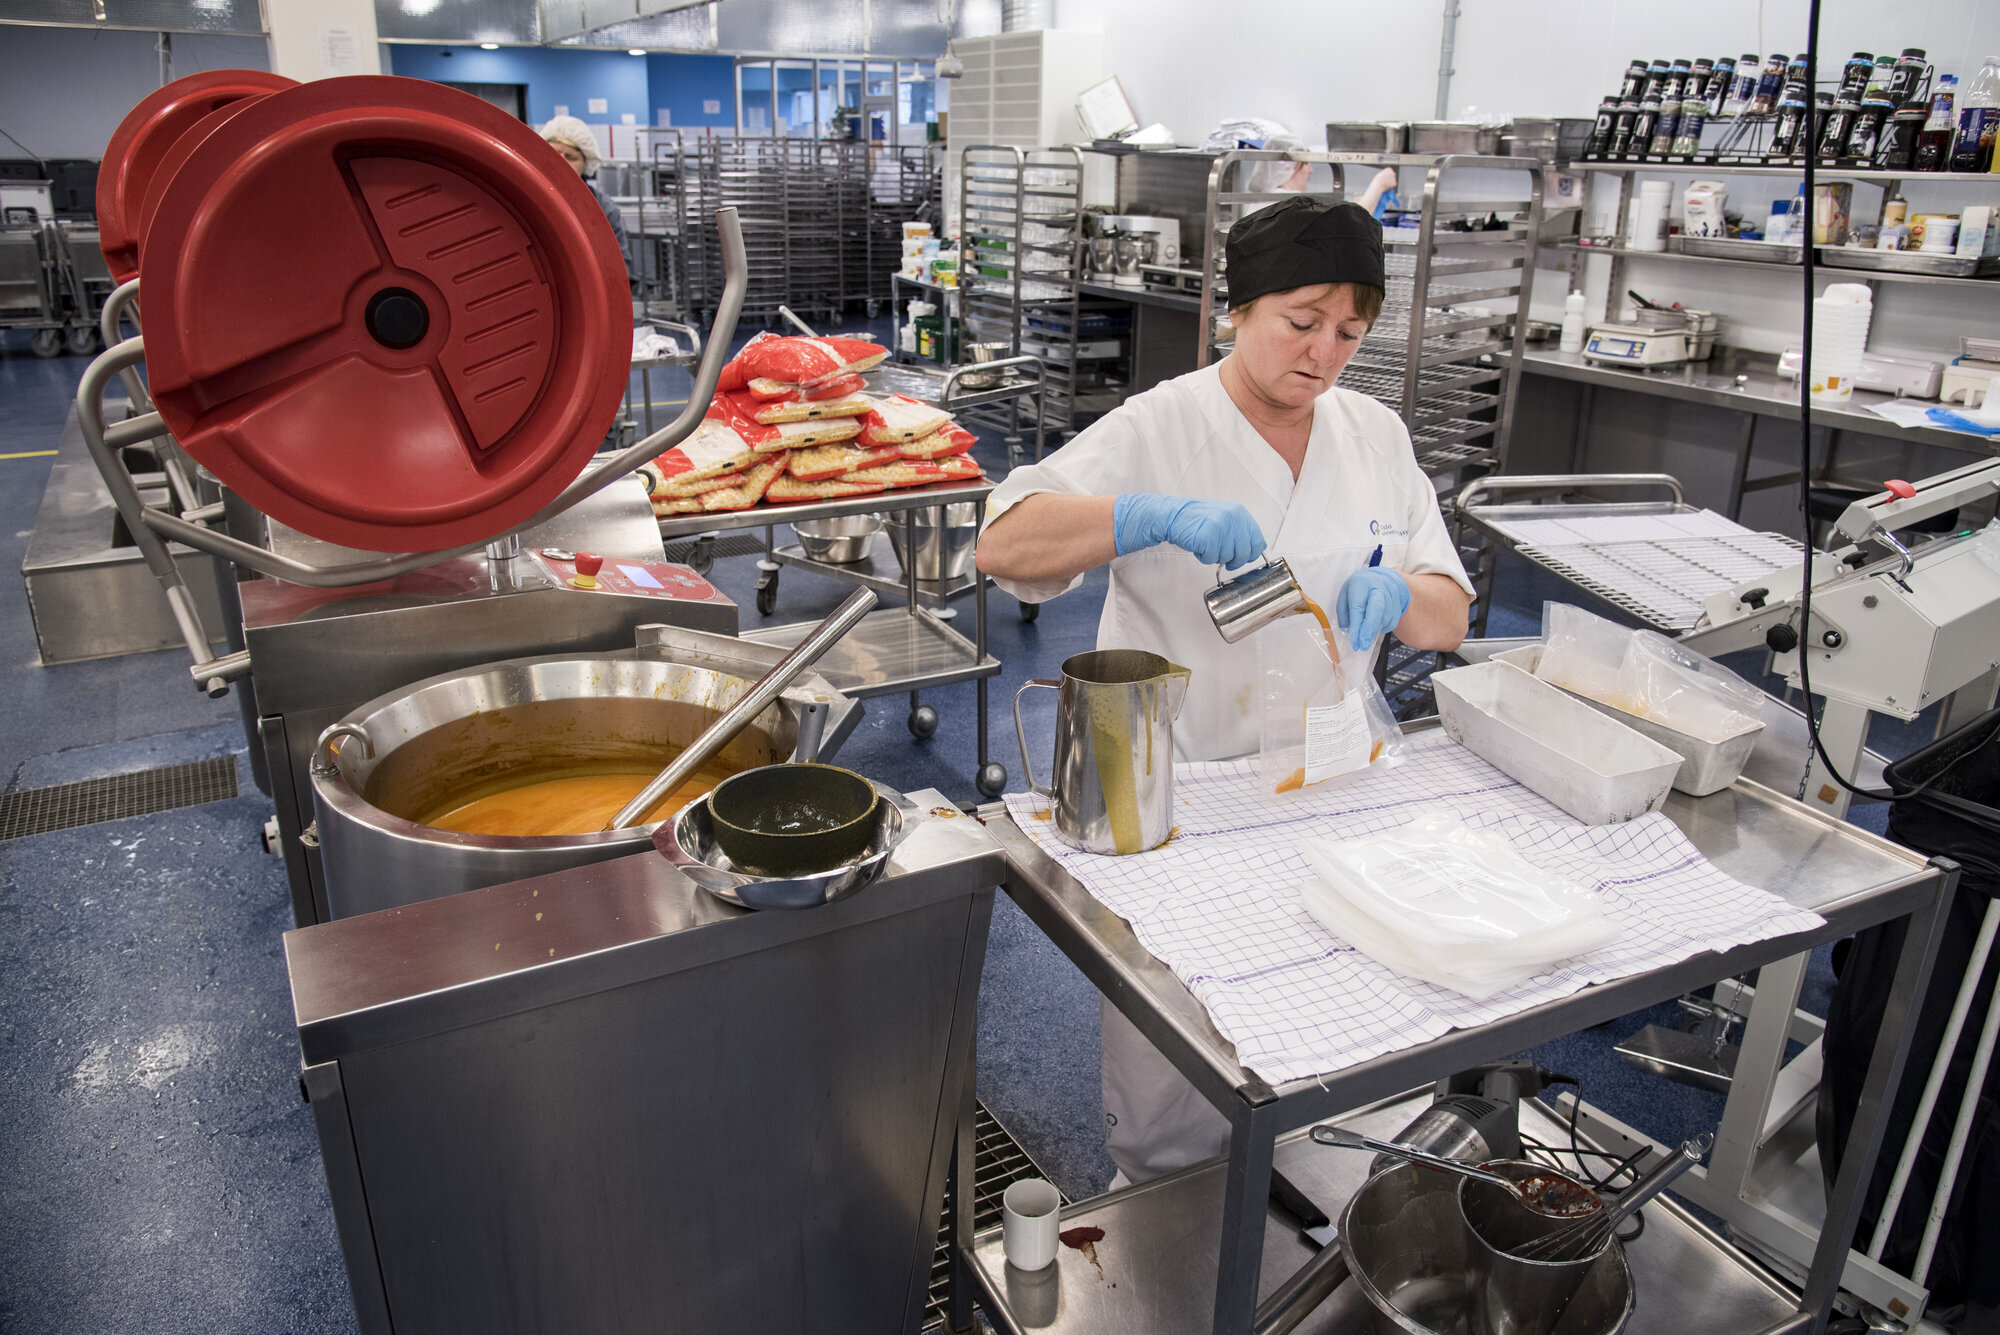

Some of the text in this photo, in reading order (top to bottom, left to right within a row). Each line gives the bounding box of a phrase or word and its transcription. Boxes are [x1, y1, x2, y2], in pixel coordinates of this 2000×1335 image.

[1889, 70, 1908, 92] P
[1595, 114, 1611, 131] D
[1616, 114, 1629, 131] L
